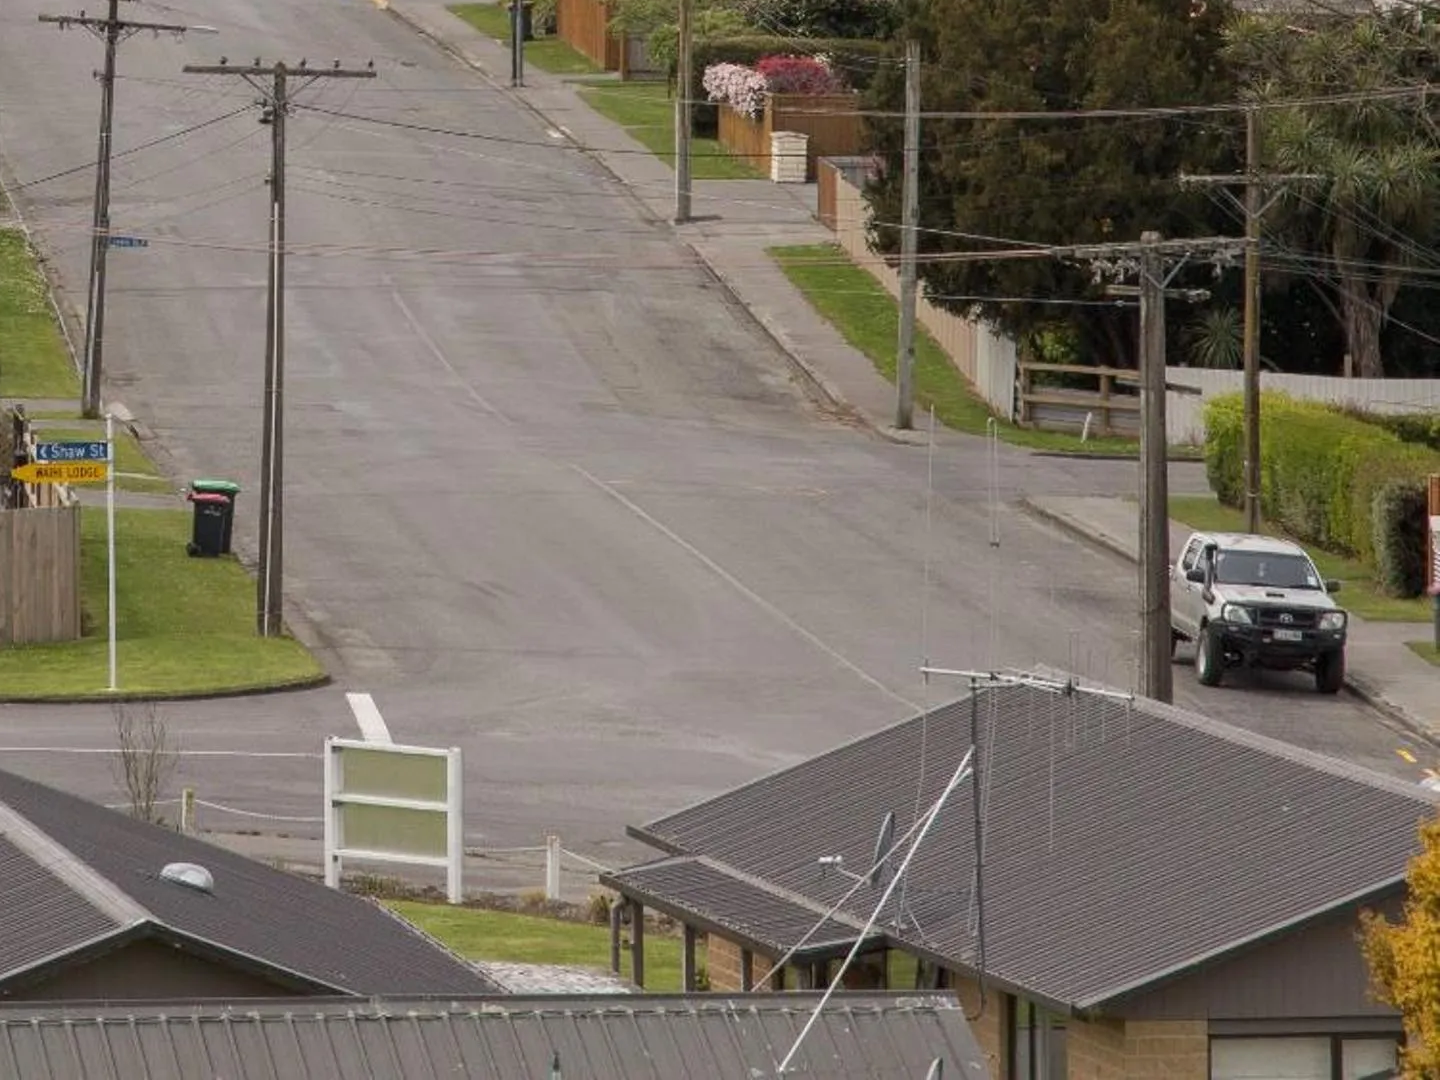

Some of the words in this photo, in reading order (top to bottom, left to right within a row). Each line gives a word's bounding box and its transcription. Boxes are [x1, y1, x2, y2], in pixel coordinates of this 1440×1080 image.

[51, 444, 85, 459] Shaw
[89, 443, 105, 458] St
[66, 466, 100, 478] LODGE
